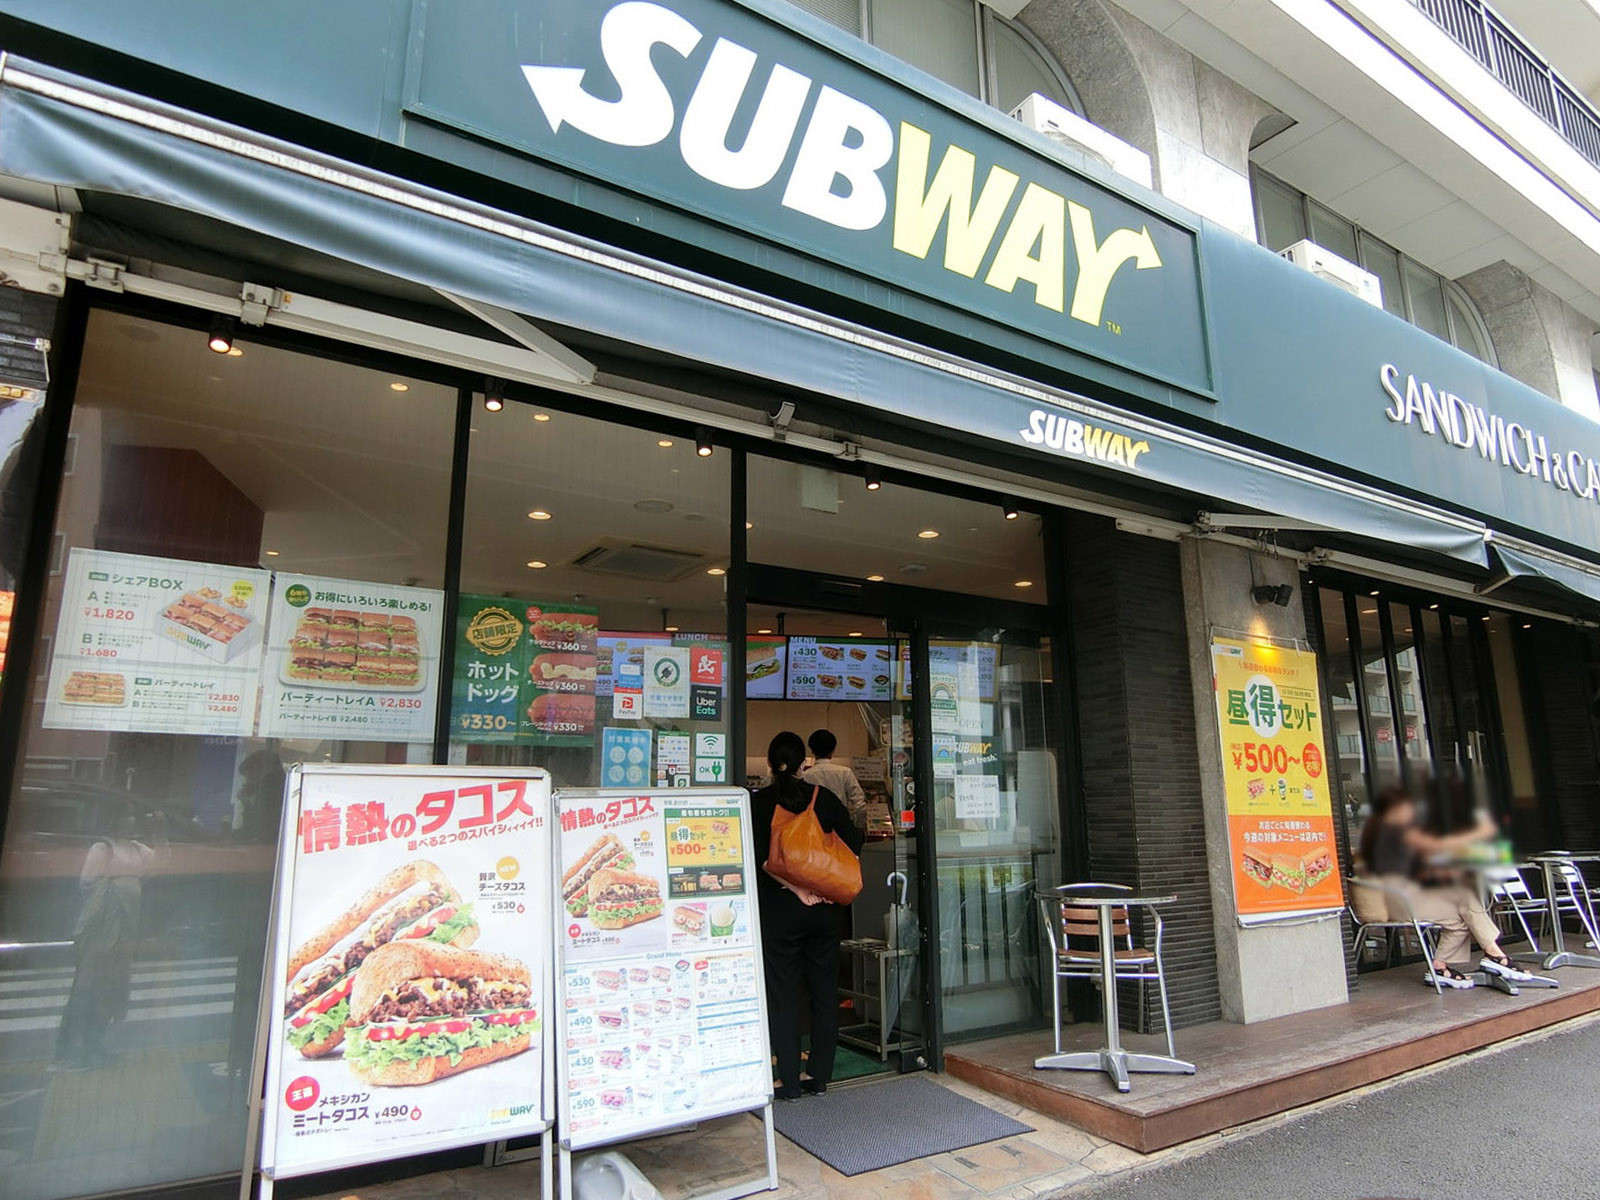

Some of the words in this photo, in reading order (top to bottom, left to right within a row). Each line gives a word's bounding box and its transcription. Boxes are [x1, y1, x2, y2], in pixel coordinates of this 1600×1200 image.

[521, 0, 1163, 327] SUBWAY
[1106, 321, 1123, 336] TM
[1019, 409, 1150, 469] SUBWAY
[112, 573, 183, 590] シェアBOX
[87, 591, 99, 601] A
[314, 591, 432, 612] お得にいろいろ楽しめる!
[84, 607, 135, 621] ¥1,820
[472, 622, 519, 640] 店舗限定
[82, 633, 93, 643] B
[675, 633, 708, 641] LUNCH
[789, 636, 817, 644] MENU
[557, 642, 580, 651] ¥360
[80, 648, 117, 657] ¥1,680
[467, 660, 520, 681] ホット
[555, 683, 578, 691] ¥360
[467, 683, 520, 704] ドッグ
[379, 698, 422, 709] ¥2,830
[696, 697, 716, 706] Uber
[696, 706, 716, 715] Eats
[1226, 683, 1318, 732] 昼得セット
[553, 723, 577, 731] ¥330
[958, 719, 984, 730] OPEN
[953, 741, 992, 754] SUBWAY
[963, 759, 975, 767] eat
[298, 780, 534, 854] 情熱のタコス
[560, 796, 655, 832] 情熱のタコス
[479, 882, 526, 892] チーズタコス
[569, 977, 591, 987] ¥530
[570, 1016, 593, 1027] ¥490
[319, 1092, 371, 1107] メキシカン
[293, 1106, 370, 1128] ミートタコス
[374, 1105, 409, 1119] ¥490
